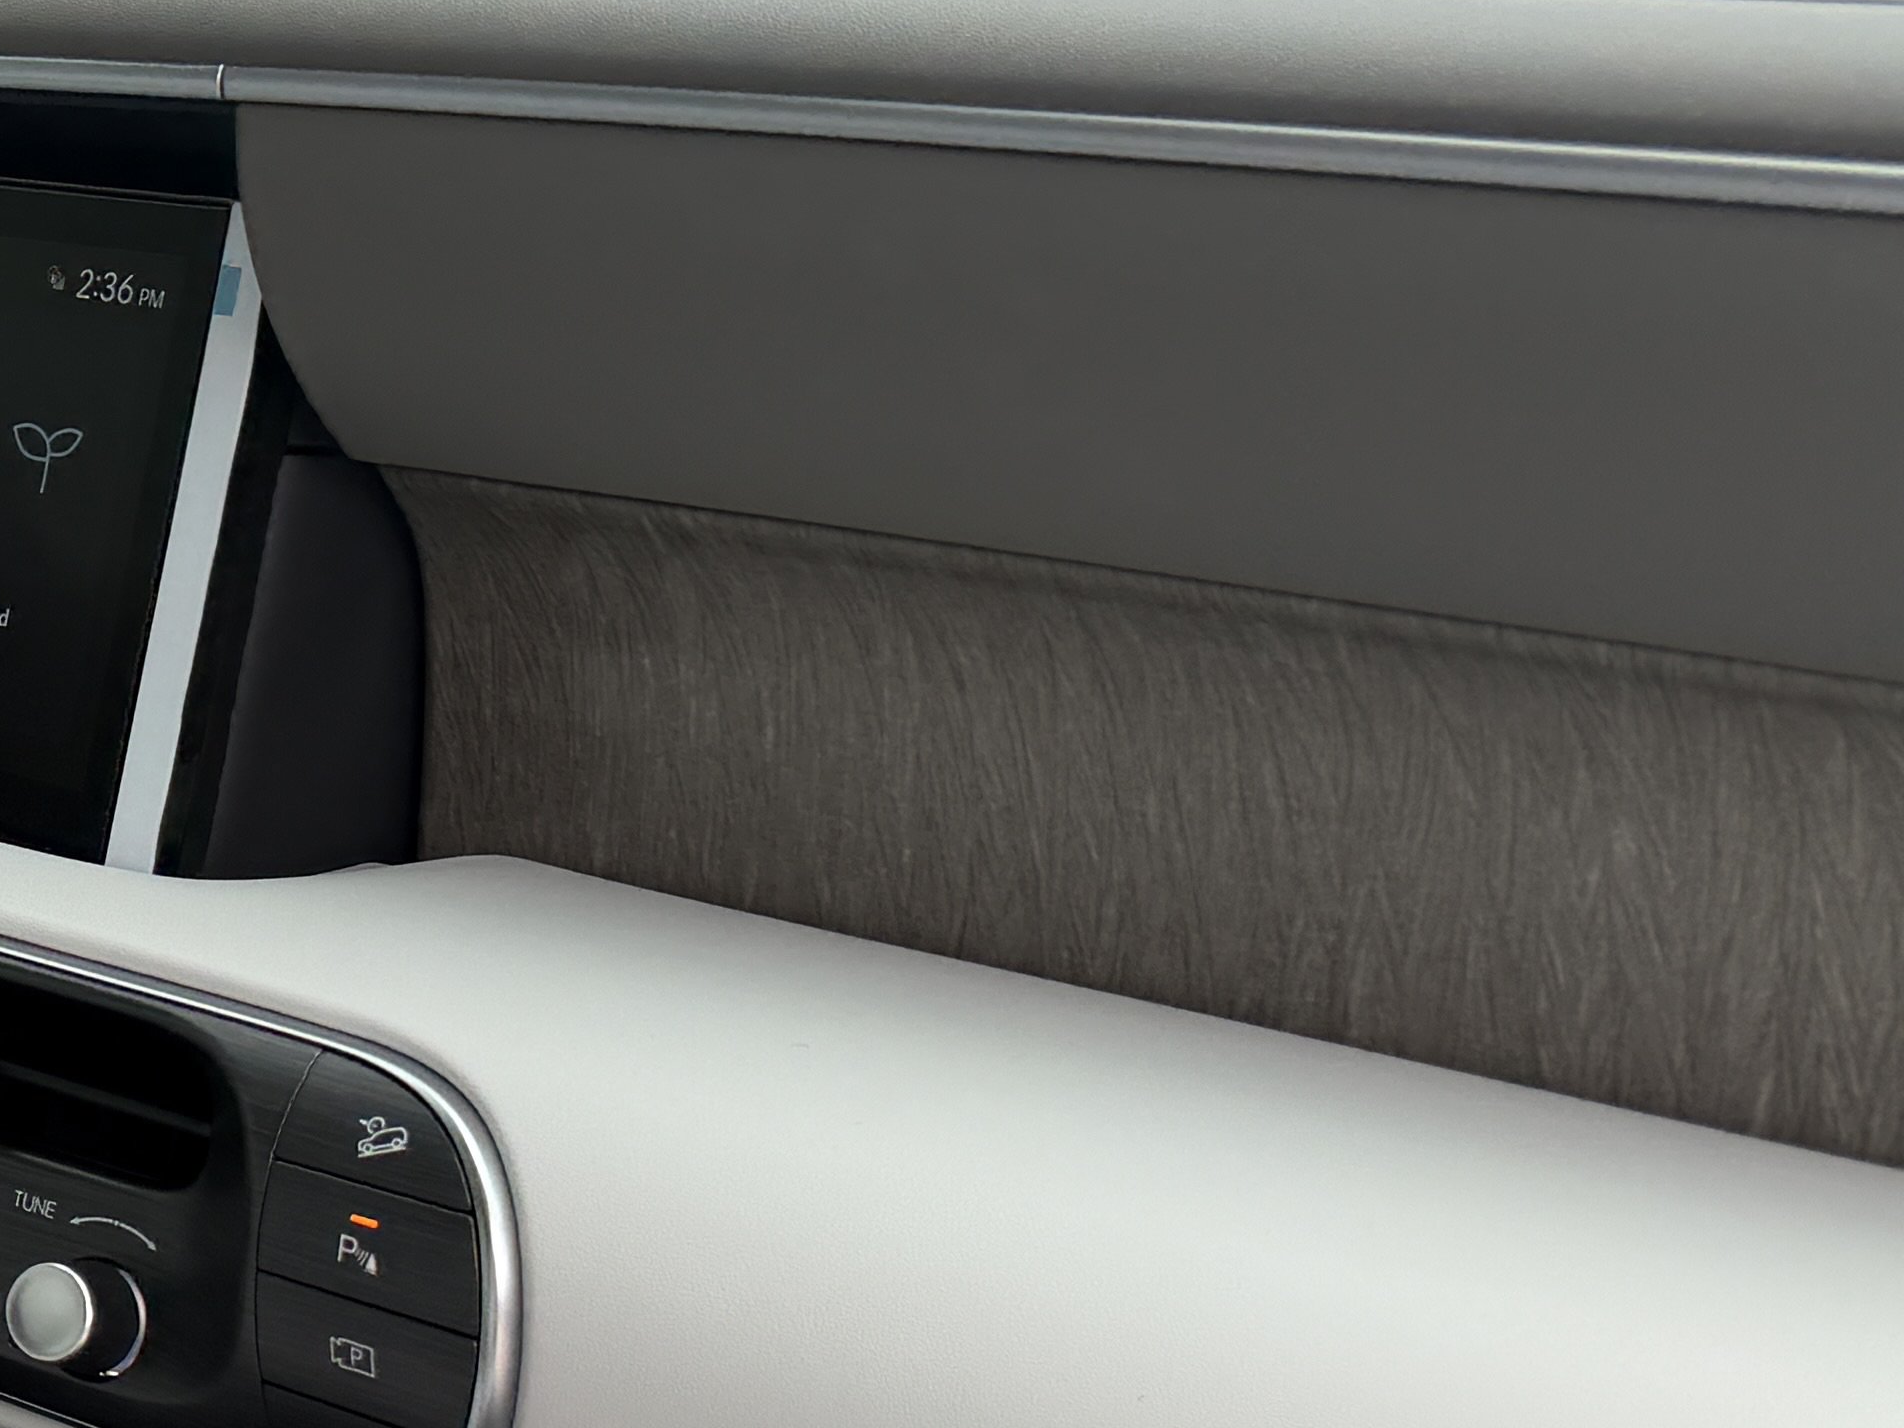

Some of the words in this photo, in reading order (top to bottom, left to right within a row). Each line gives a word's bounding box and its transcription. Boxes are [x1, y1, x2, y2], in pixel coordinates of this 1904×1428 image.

[76, 268, 135, 306] 2:36
[138, 287, 165, 310] PM
[14, 1189, 58, 1219] TUNE
